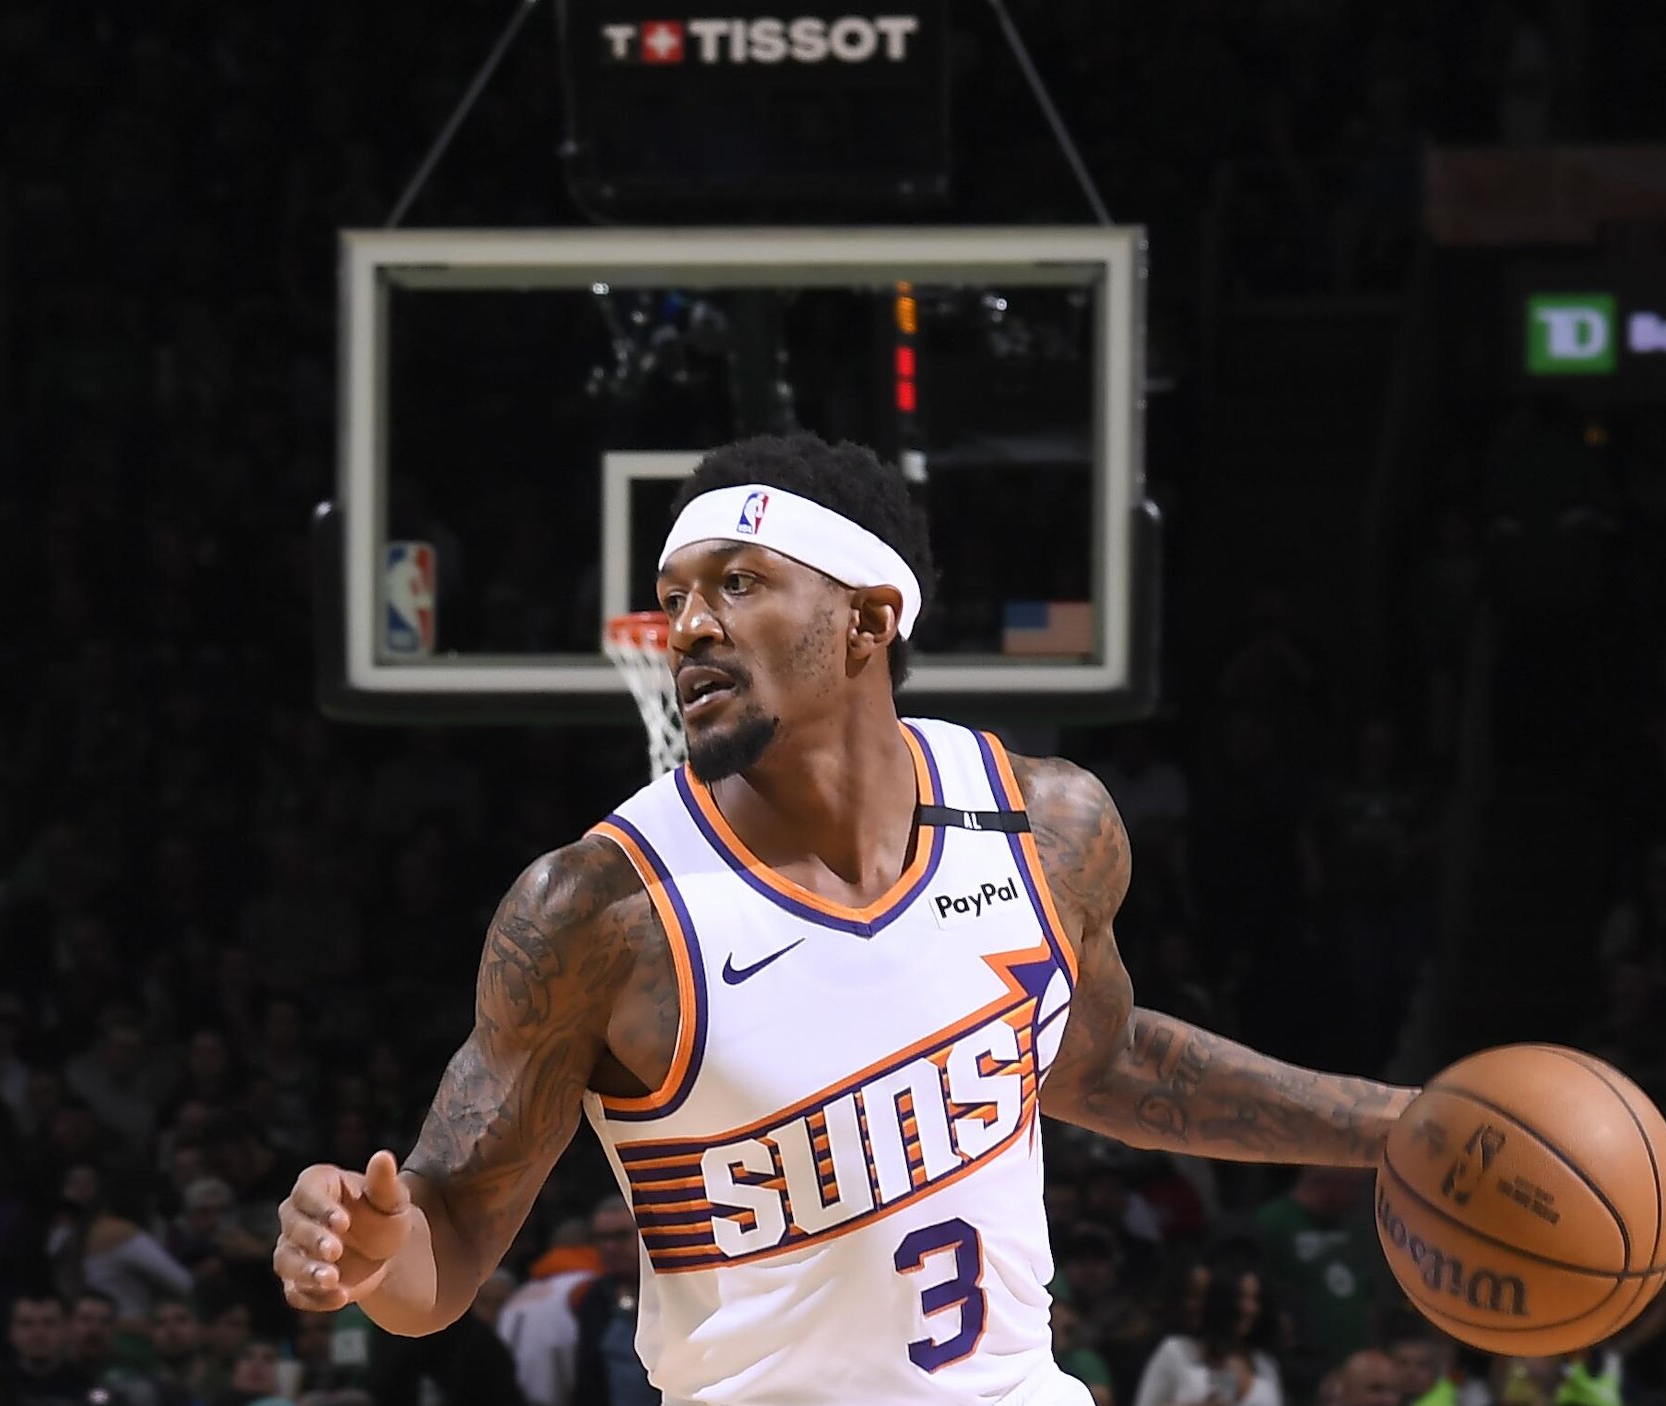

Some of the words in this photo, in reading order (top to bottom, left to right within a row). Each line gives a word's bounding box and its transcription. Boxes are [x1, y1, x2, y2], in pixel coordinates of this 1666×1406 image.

[689, 17, 918, 62] TISSOT
[1537, 306, 1608, 359] TD
[935, 877, 1019, 919] PayPal
[699, 1018, 1023, 1258] SUNS
[893, 1217, 987, 1373] 3
